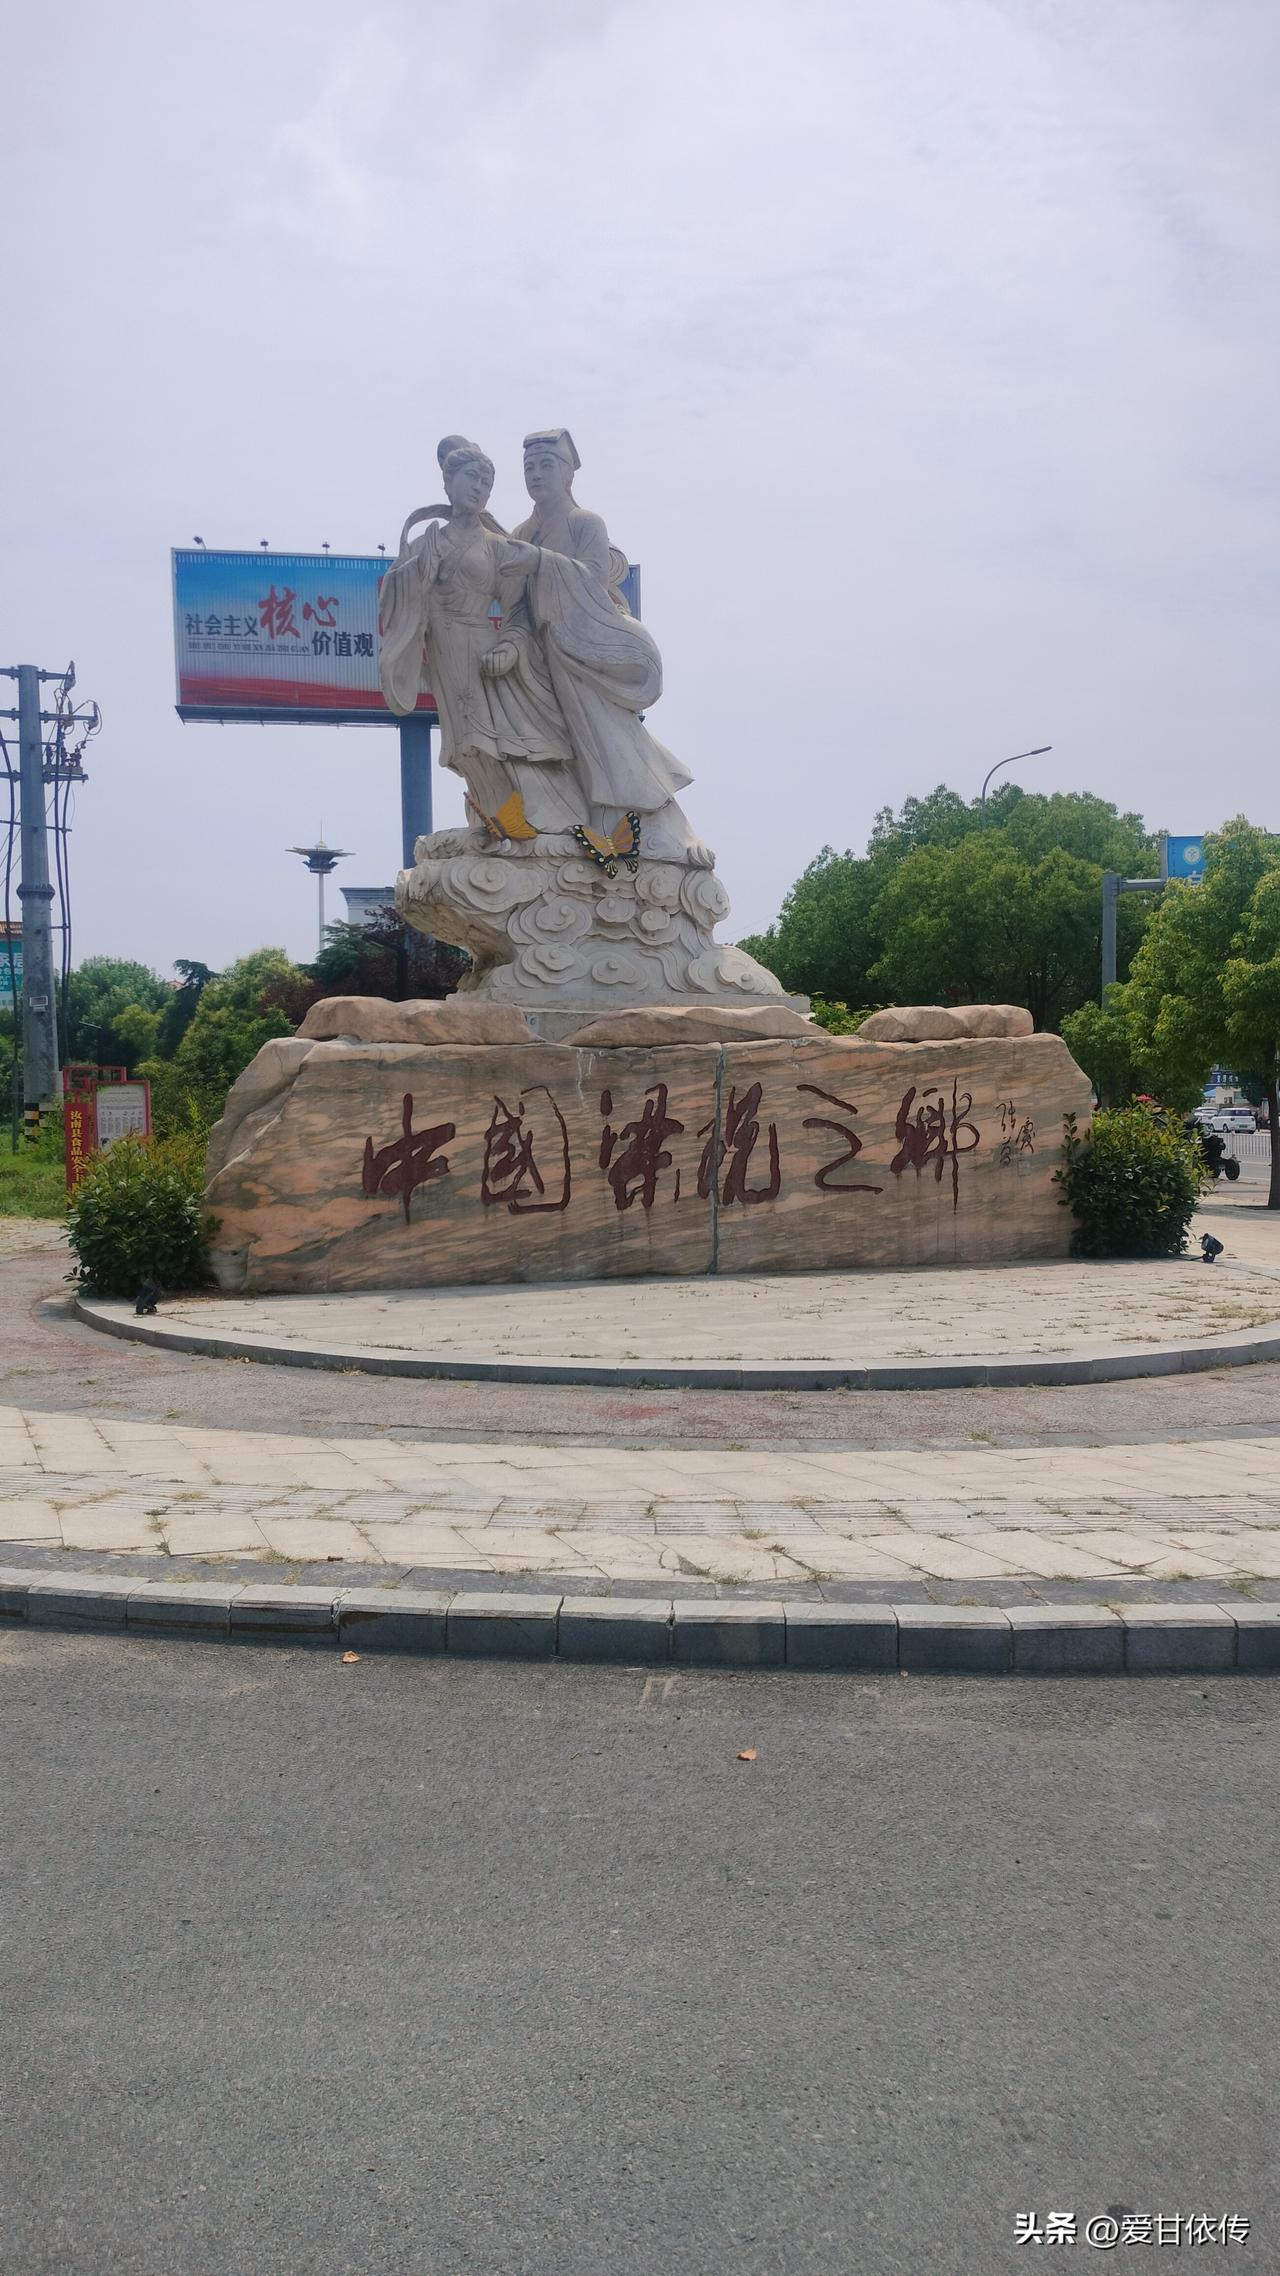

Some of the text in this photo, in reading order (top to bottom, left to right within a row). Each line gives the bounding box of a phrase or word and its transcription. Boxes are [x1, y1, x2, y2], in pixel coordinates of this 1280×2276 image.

[185, 584, 374, 657] 社会主义 核心 价值观
